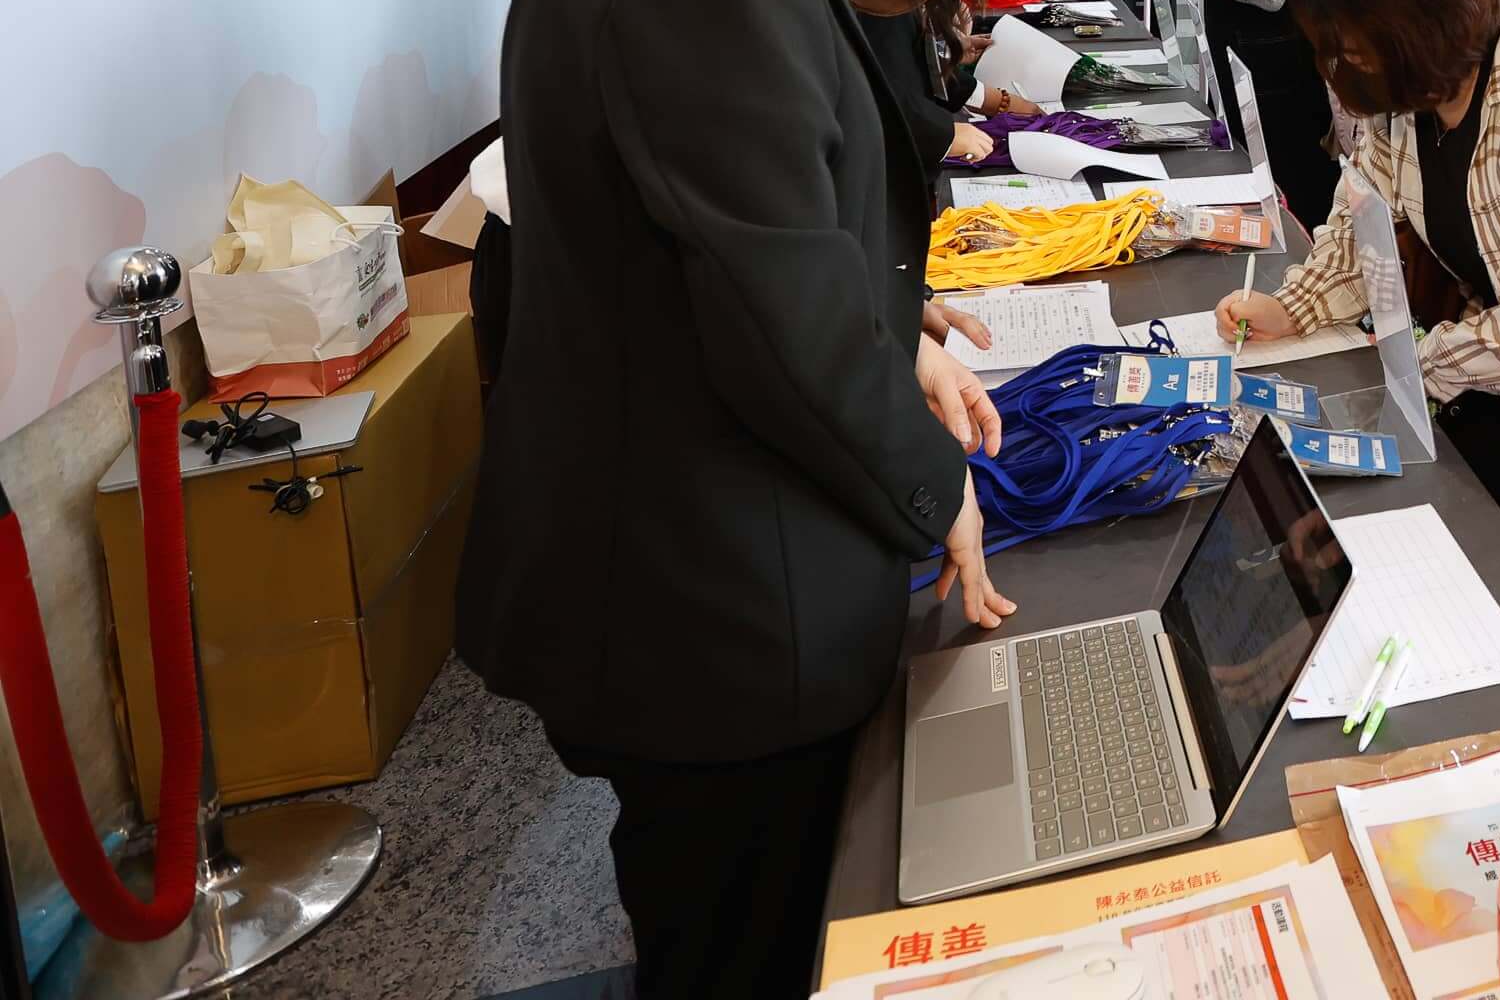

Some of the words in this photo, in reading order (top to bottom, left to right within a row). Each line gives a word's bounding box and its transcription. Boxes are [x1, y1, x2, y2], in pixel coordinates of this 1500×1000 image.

[1096, 871, 1222, 911] 陳永泰公益信託
[884, 922, 988, 969] 傳善
